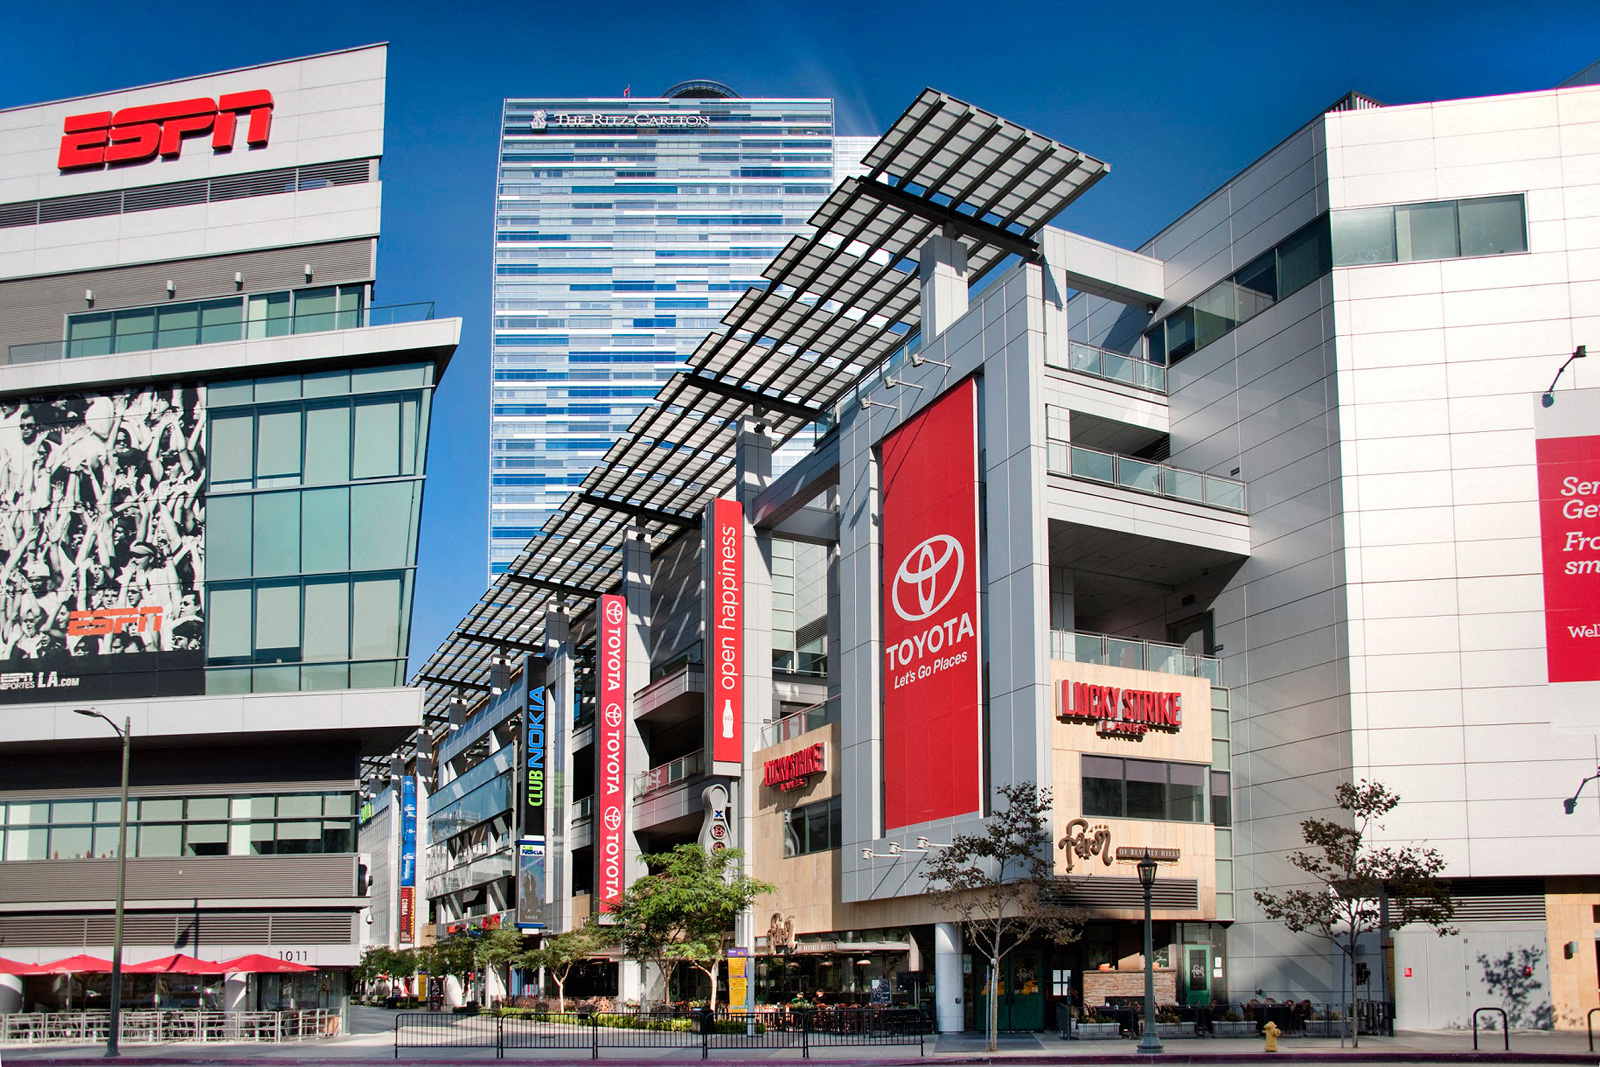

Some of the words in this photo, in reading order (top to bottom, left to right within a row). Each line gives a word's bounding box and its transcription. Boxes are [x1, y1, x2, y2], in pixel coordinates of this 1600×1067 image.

[57, 89, 274, 170] ESPN
[554, 113, 587, 126] THE
[591, 113, 710, 127] RITZ-CARLTON
[1562, 499, 1600, 519] Ge
[718, 526, 738, 630] happiness
[68, 606, 163, 636] ESPN
[1567, 624, 1600, 638] Wel
[607, 627, 621, 691] TOYOTA
[886, 612, 974, 671] TOYOTA
[37, 671, 80, 688] LA.COM
[721, 638, 738, 689] open
[894, 670, 916, 689] Let's
[917, 665, 932, 680] Go
[933, 651, 968, 674] Places
[0, 681, 35, 690] EPORTES
[1061, 680, 1120, 720] LUCKY
[1121, 689, 1182, 725] STRIKE
[528, 686, 545, 768] NOKIA
[1101, 721, 1148, 734] LANES
[607, 730, 620, 795] TOYOTA
[528, 770, 543, 807] CLUB
[606, 833, 619, 899] TOYOTA
[279, 951, 307, 961] 1011
